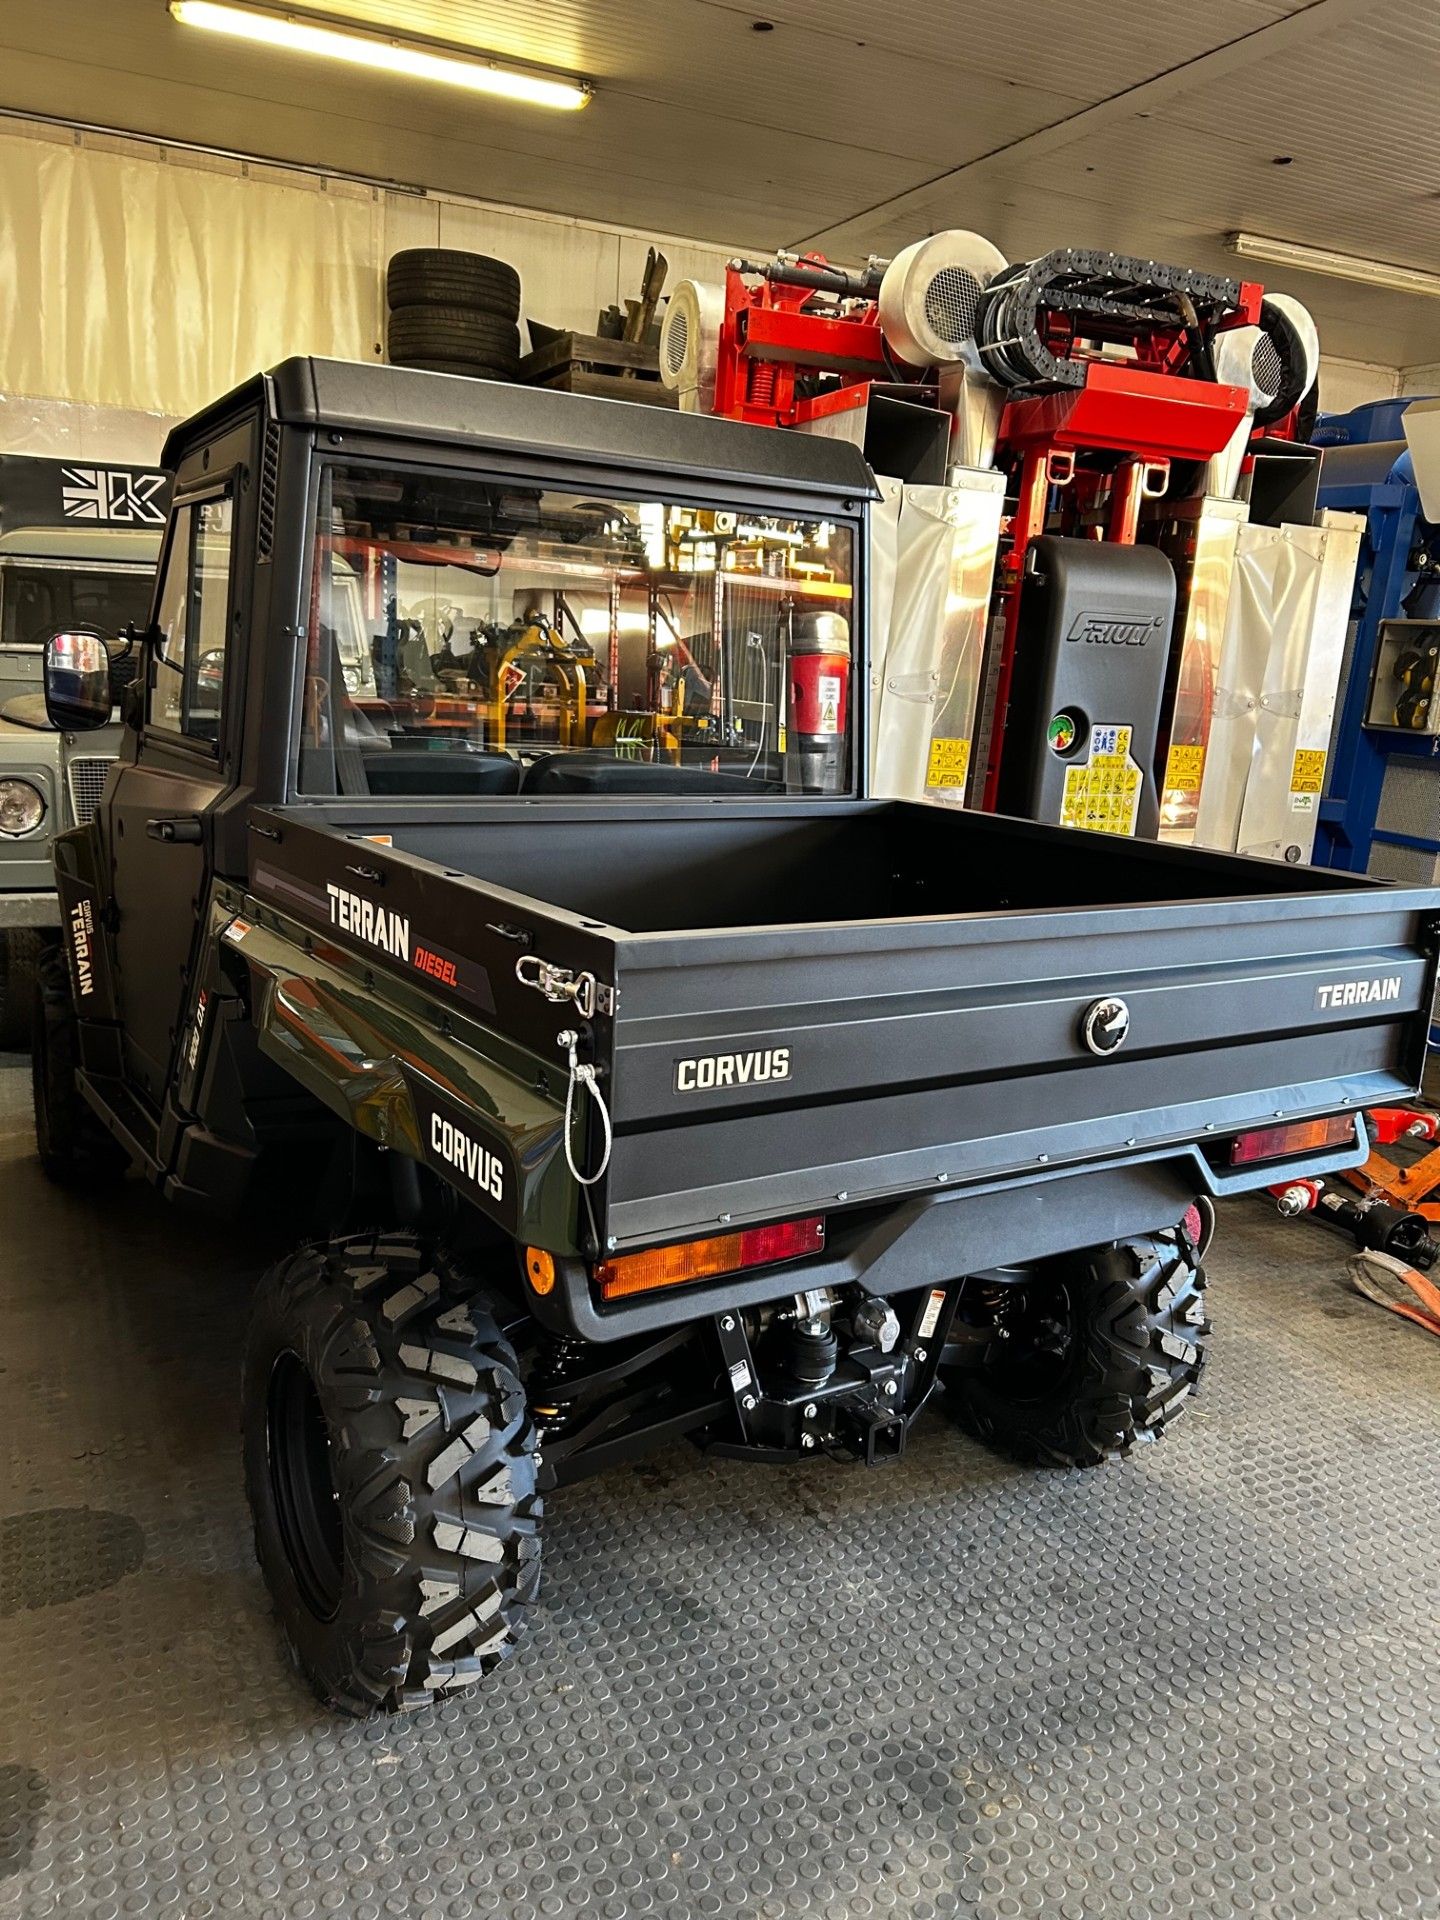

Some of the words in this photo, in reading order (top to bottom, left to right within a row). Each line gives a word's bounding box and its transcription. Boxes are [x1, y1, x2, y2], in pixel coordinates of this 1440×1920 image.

[71, 902, 93, 996] TERRAIN
[82, 900, 94, 934] CORVUS
[327, 883, 409, 962] TERRAIN
[414, 946, 459, 988] DIESEL
[1318, 976, 1401, 1009] TERRAIN
[677, 1048, 790, 1091] CORVUS
[431, 1112, 503, 1202] CORVUS
